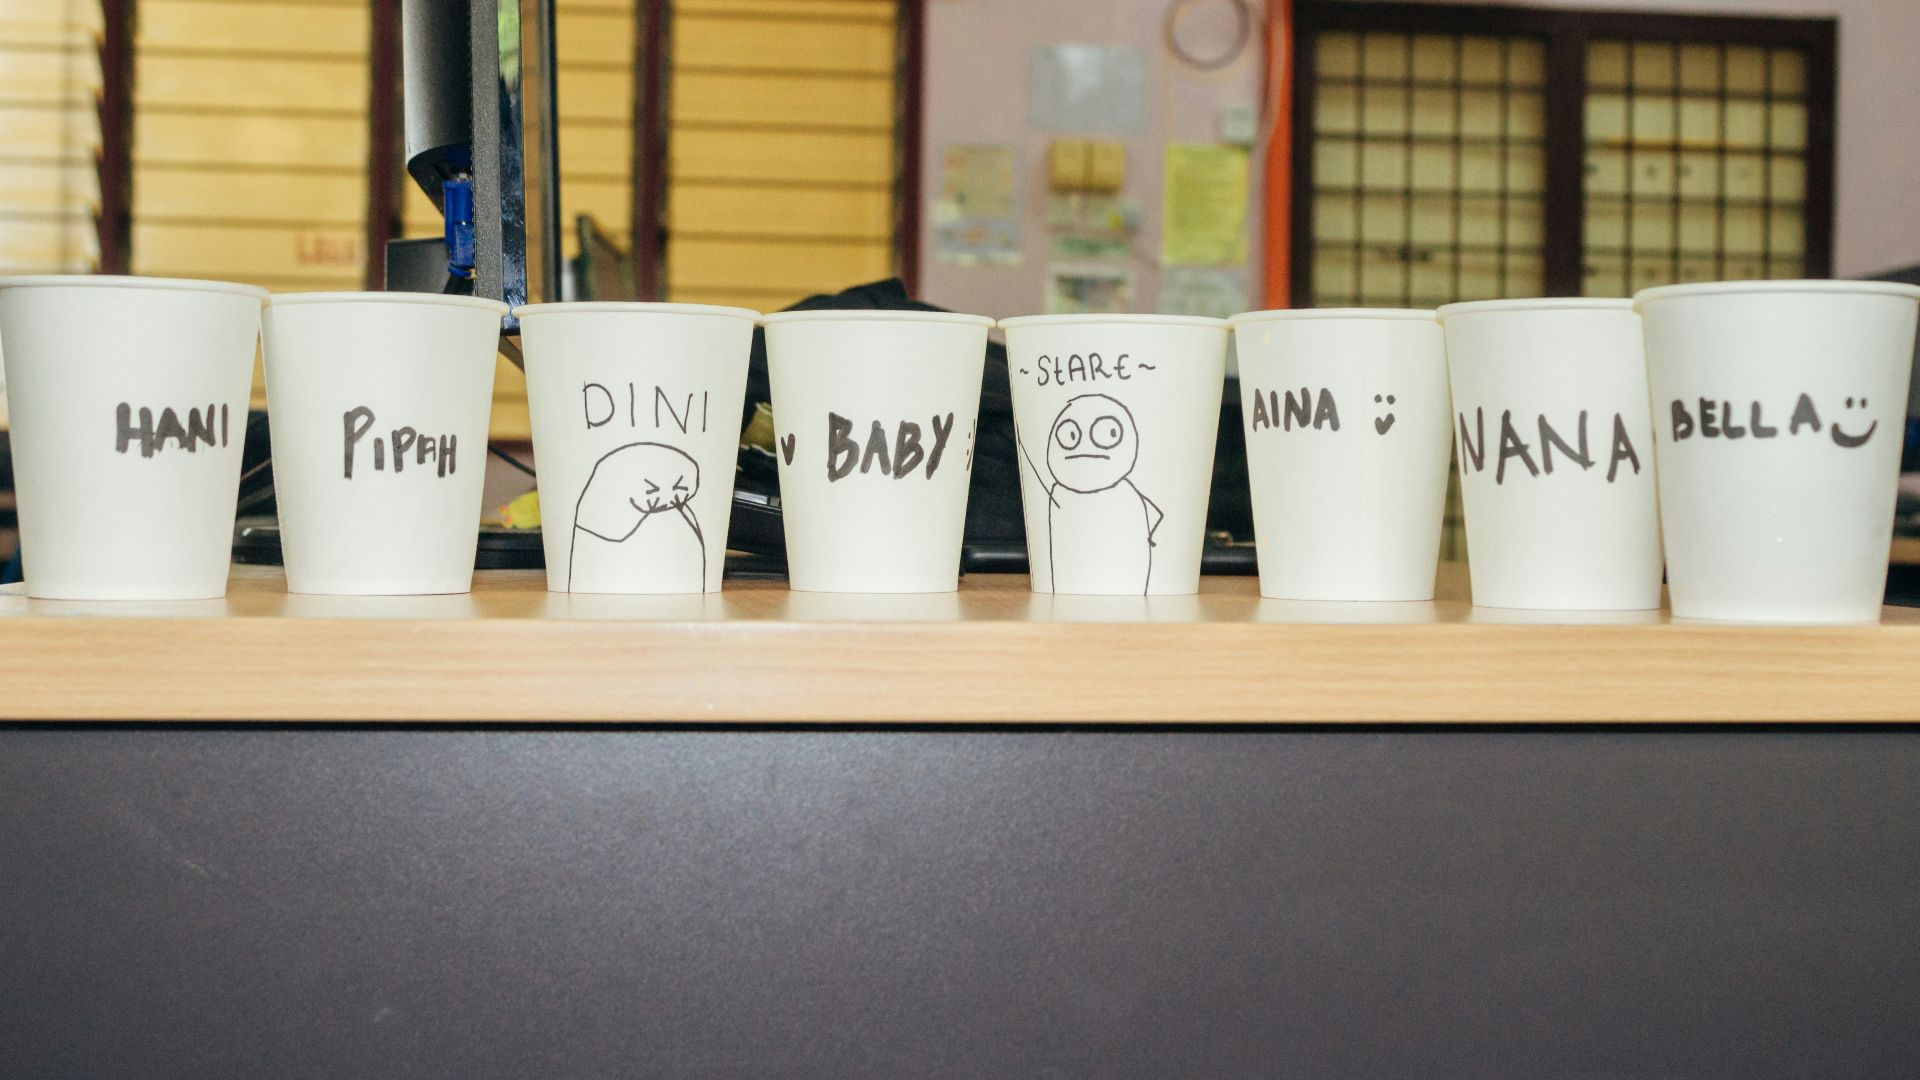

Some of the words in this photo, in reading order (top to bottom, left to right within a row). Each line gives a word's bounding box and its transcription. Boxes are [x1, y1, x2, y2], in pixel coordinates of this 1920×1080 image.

[115, 402, 229, 459] HANI
[583, 382, 708, 434] DINI
[1252, 387, 1340, 433] AINA
[1670, 393, 1822, 443] BELLA
[827, 411, 954, 483] BABY
[1459, 406, 1641, 486] NANA
